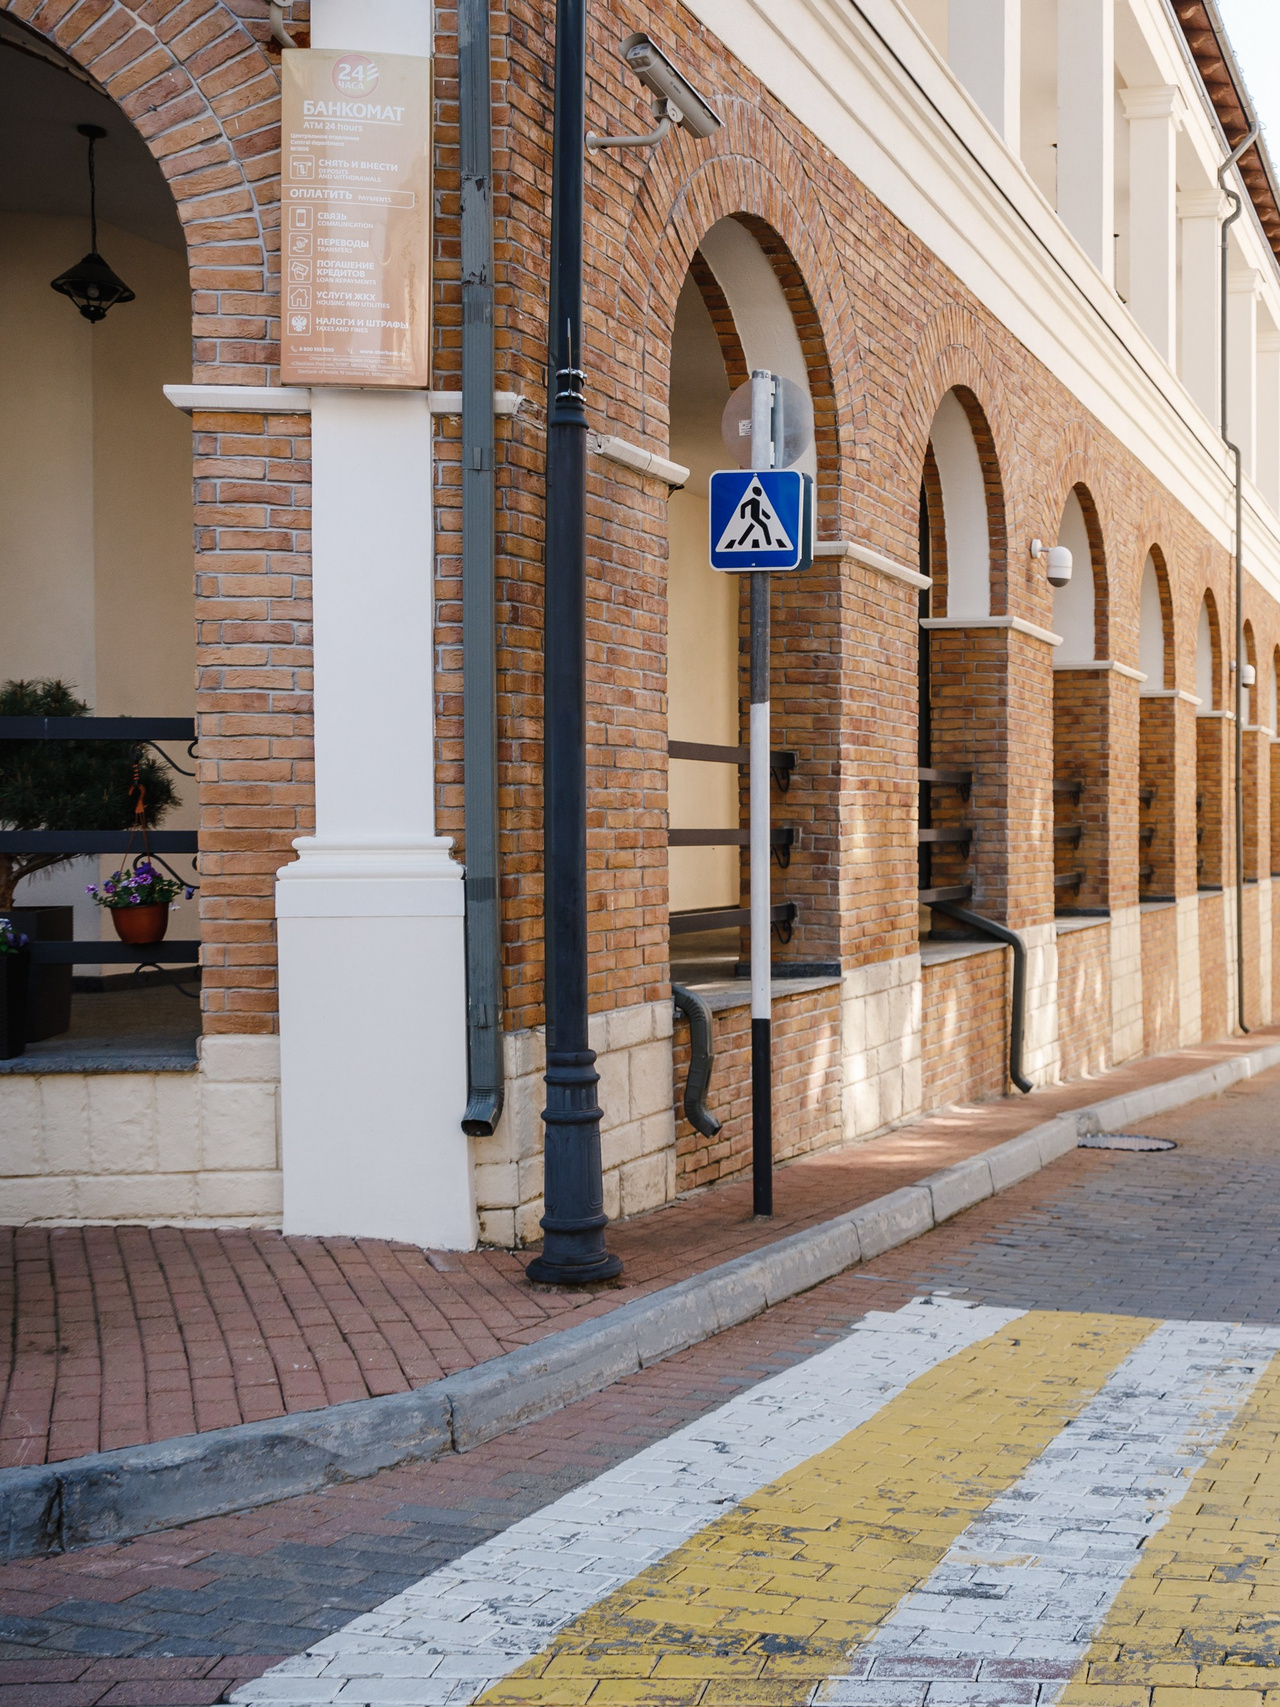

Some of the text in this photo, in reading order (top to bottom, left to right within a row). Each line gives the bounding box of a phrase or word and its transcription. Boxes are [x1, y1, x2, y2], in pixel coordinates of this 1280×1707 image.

[338, 63, 364, 81] 24
[338, 81, 364, 90] ЧАСА
[303, 100, 405, 121] БАНКОМАТ
[338, 122, 364, 132] hours
[319, 159, 349, 167] СНЯТЬ
[361, 162, 398, 171] ВНЕСТИ
[290, 189, 353, 200] ОПЛАТИТЬ
[317, 220, 374, 228] COMMUNICATION
[317, 238, 369, 248] ПЕРЕВОДЫ
[317, 260, 375, 270] ПОГАШЕНИЕ
[317, 269, 365, 277] КРЕДИТОВ
[316, 291, 376, 301] УСЛУГИ ЖКХ
[316, 317, 355, 326] НАЛОГИ
[366, 320, 409, 329] ШТРАФЫ
